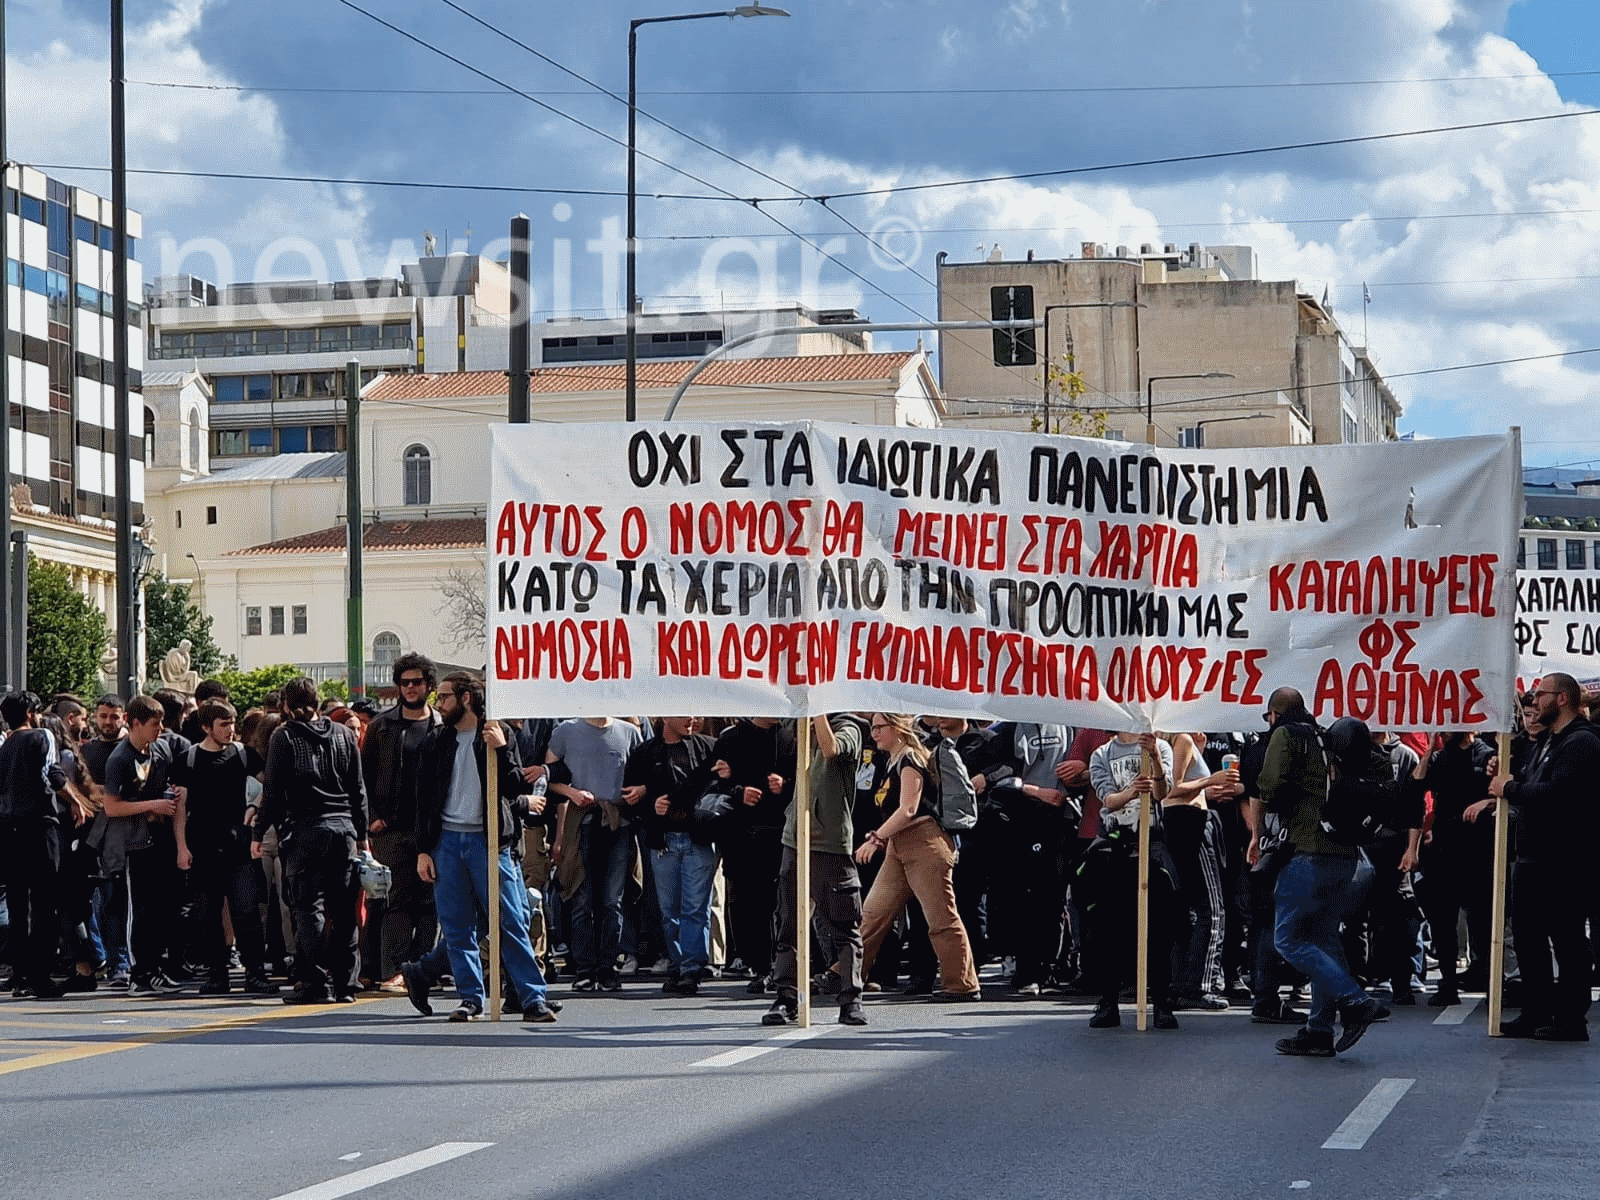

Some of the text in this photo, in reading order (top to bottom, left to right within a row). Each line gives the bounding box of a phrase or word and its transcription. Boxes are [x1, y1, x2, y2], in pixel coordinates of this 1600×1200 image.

[629, 430, 1329, 525] ΟΧΙ ΣΤΑ ΙΔΙΩΤΙΚΑ ΠΑΝΕΠΙΣΤΗΜΙΑ
[496, 499, 1199, 589] ΑΥΤΟΣ Ο ΝΟΜΟΣ ΘΑ ΜΕΙΝΕΙ ΣΤΑ ΧΑΡΤΙΑ
[498, 557, 1249, 639] ΚΑΤΩ ΤΑ ΧΕΡΙΑ ΑΠΟ ΤΗΝ ΠΡΟΟΠΤΙΚΗ ΜΑΣ
[1268, 553, 1499, 619] ΚΑΤΑΛΗΨΕΙΣ
[496, 618, 633, 683] ΔΗΜΟΣΙΑ
[657, 619, 712, 677] ΚΑΙ
[717, 619, 840, 686] ΔΩΡΕΑΝ
[1358, 620, 1419, 673] ΦΣ
[1514, 617, 1549, 657] ΦΣ
[1313, 658, 1487, 726] ΑΘΗΝΑΣ
